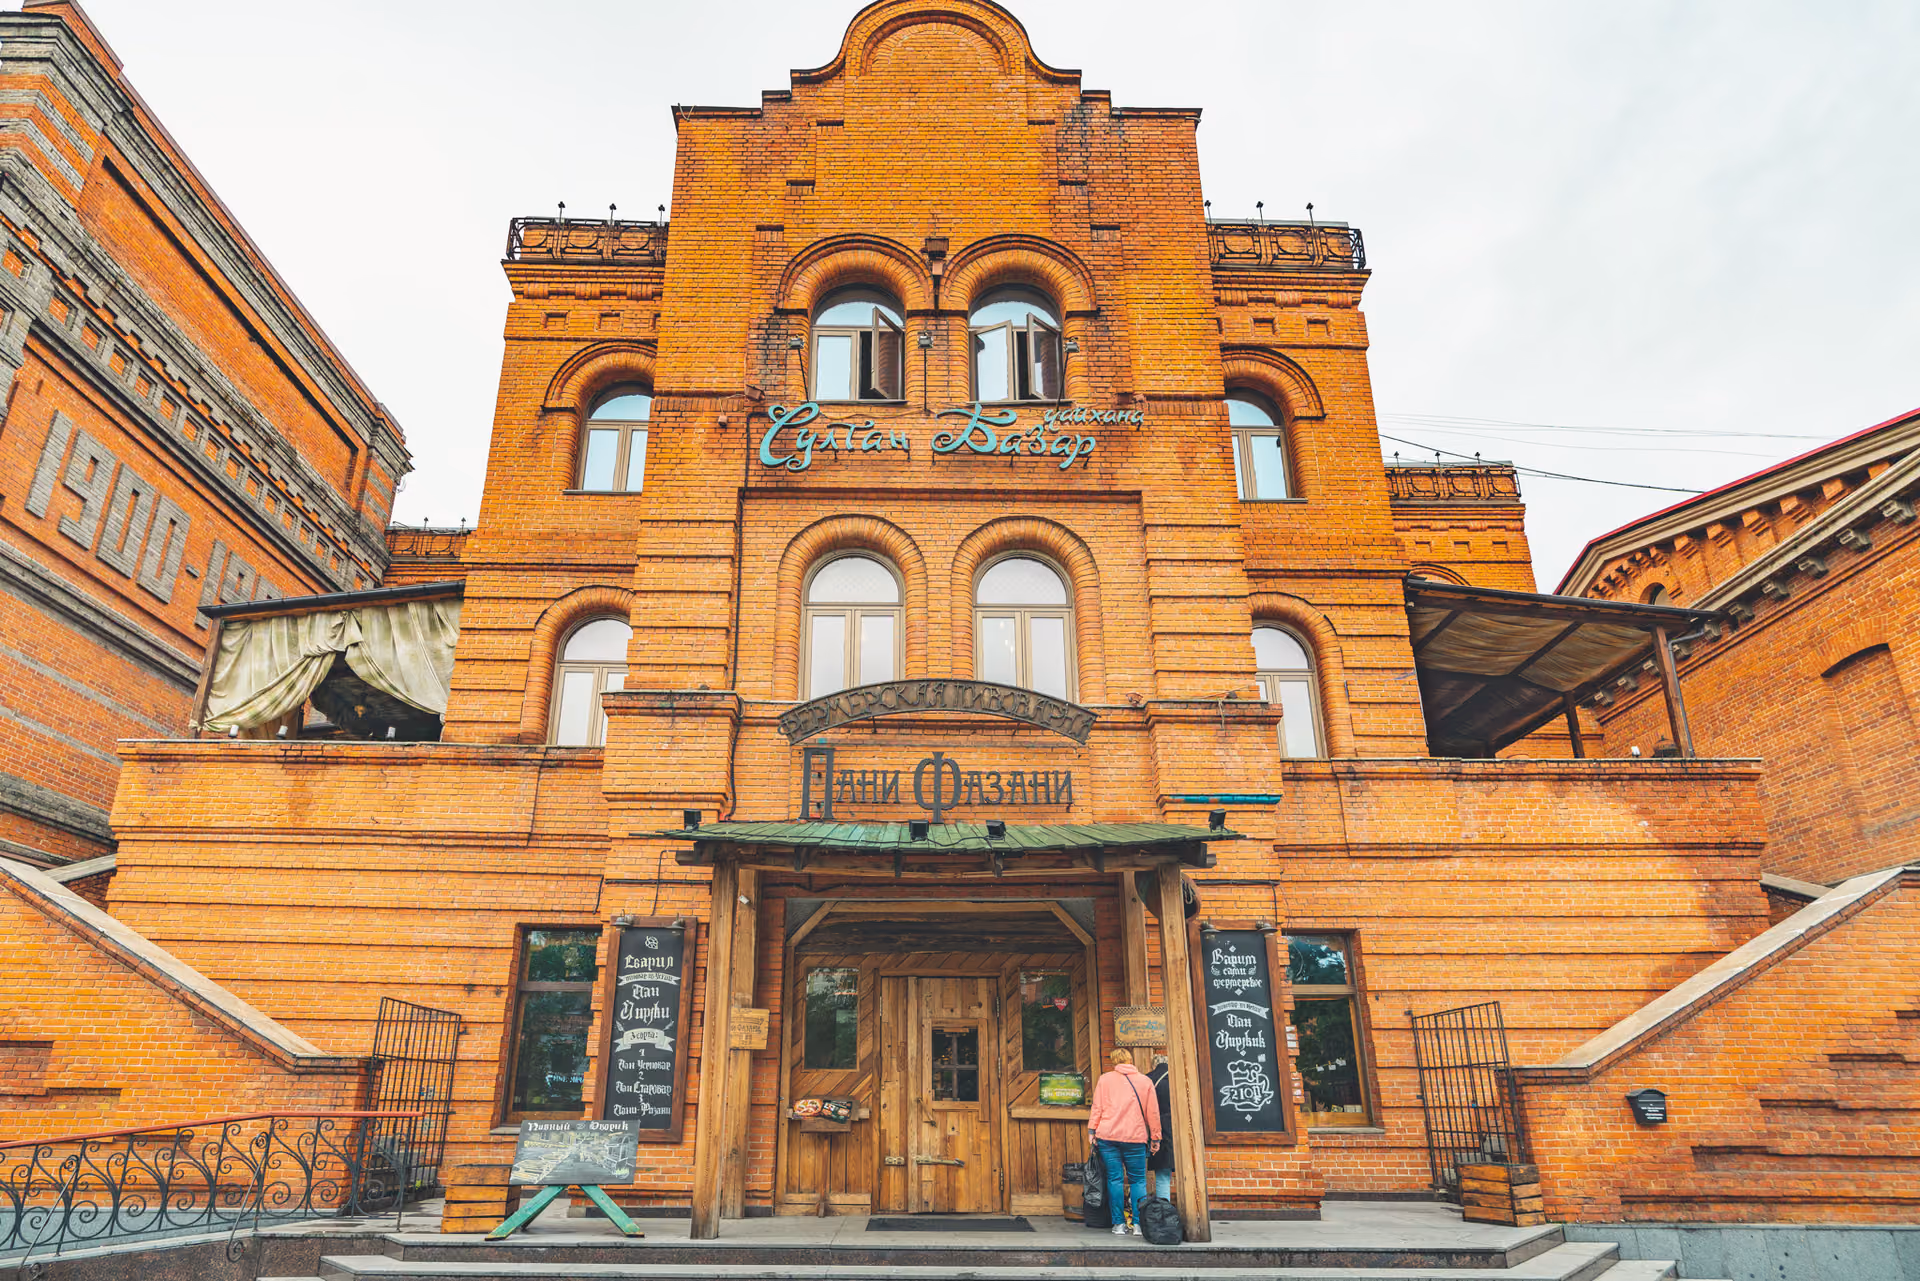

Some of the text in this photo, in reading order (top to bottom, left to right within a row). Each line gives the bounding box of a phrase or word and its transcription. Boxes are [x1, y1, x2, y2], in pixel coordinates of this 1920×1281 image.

[1043, 406, 1144, 433] чайхана
[759, 402, 1097, 471] Султан Базар
[778, 682, 1096, 742] ФЕРМЕРСКАЯ ПИВОВАРНЯ
[632, 984, 660, 1000] Пан
[1226, 1013, 1252, 1028] Пан
[638, 1048, 645, 1056] 1
[618, 1058, 635, 1071] Пан
[638, 1071, 645, 1080] 2
[615, 1081, 633, 1094] Пан
[638, 1094, 644, 1103] 3
